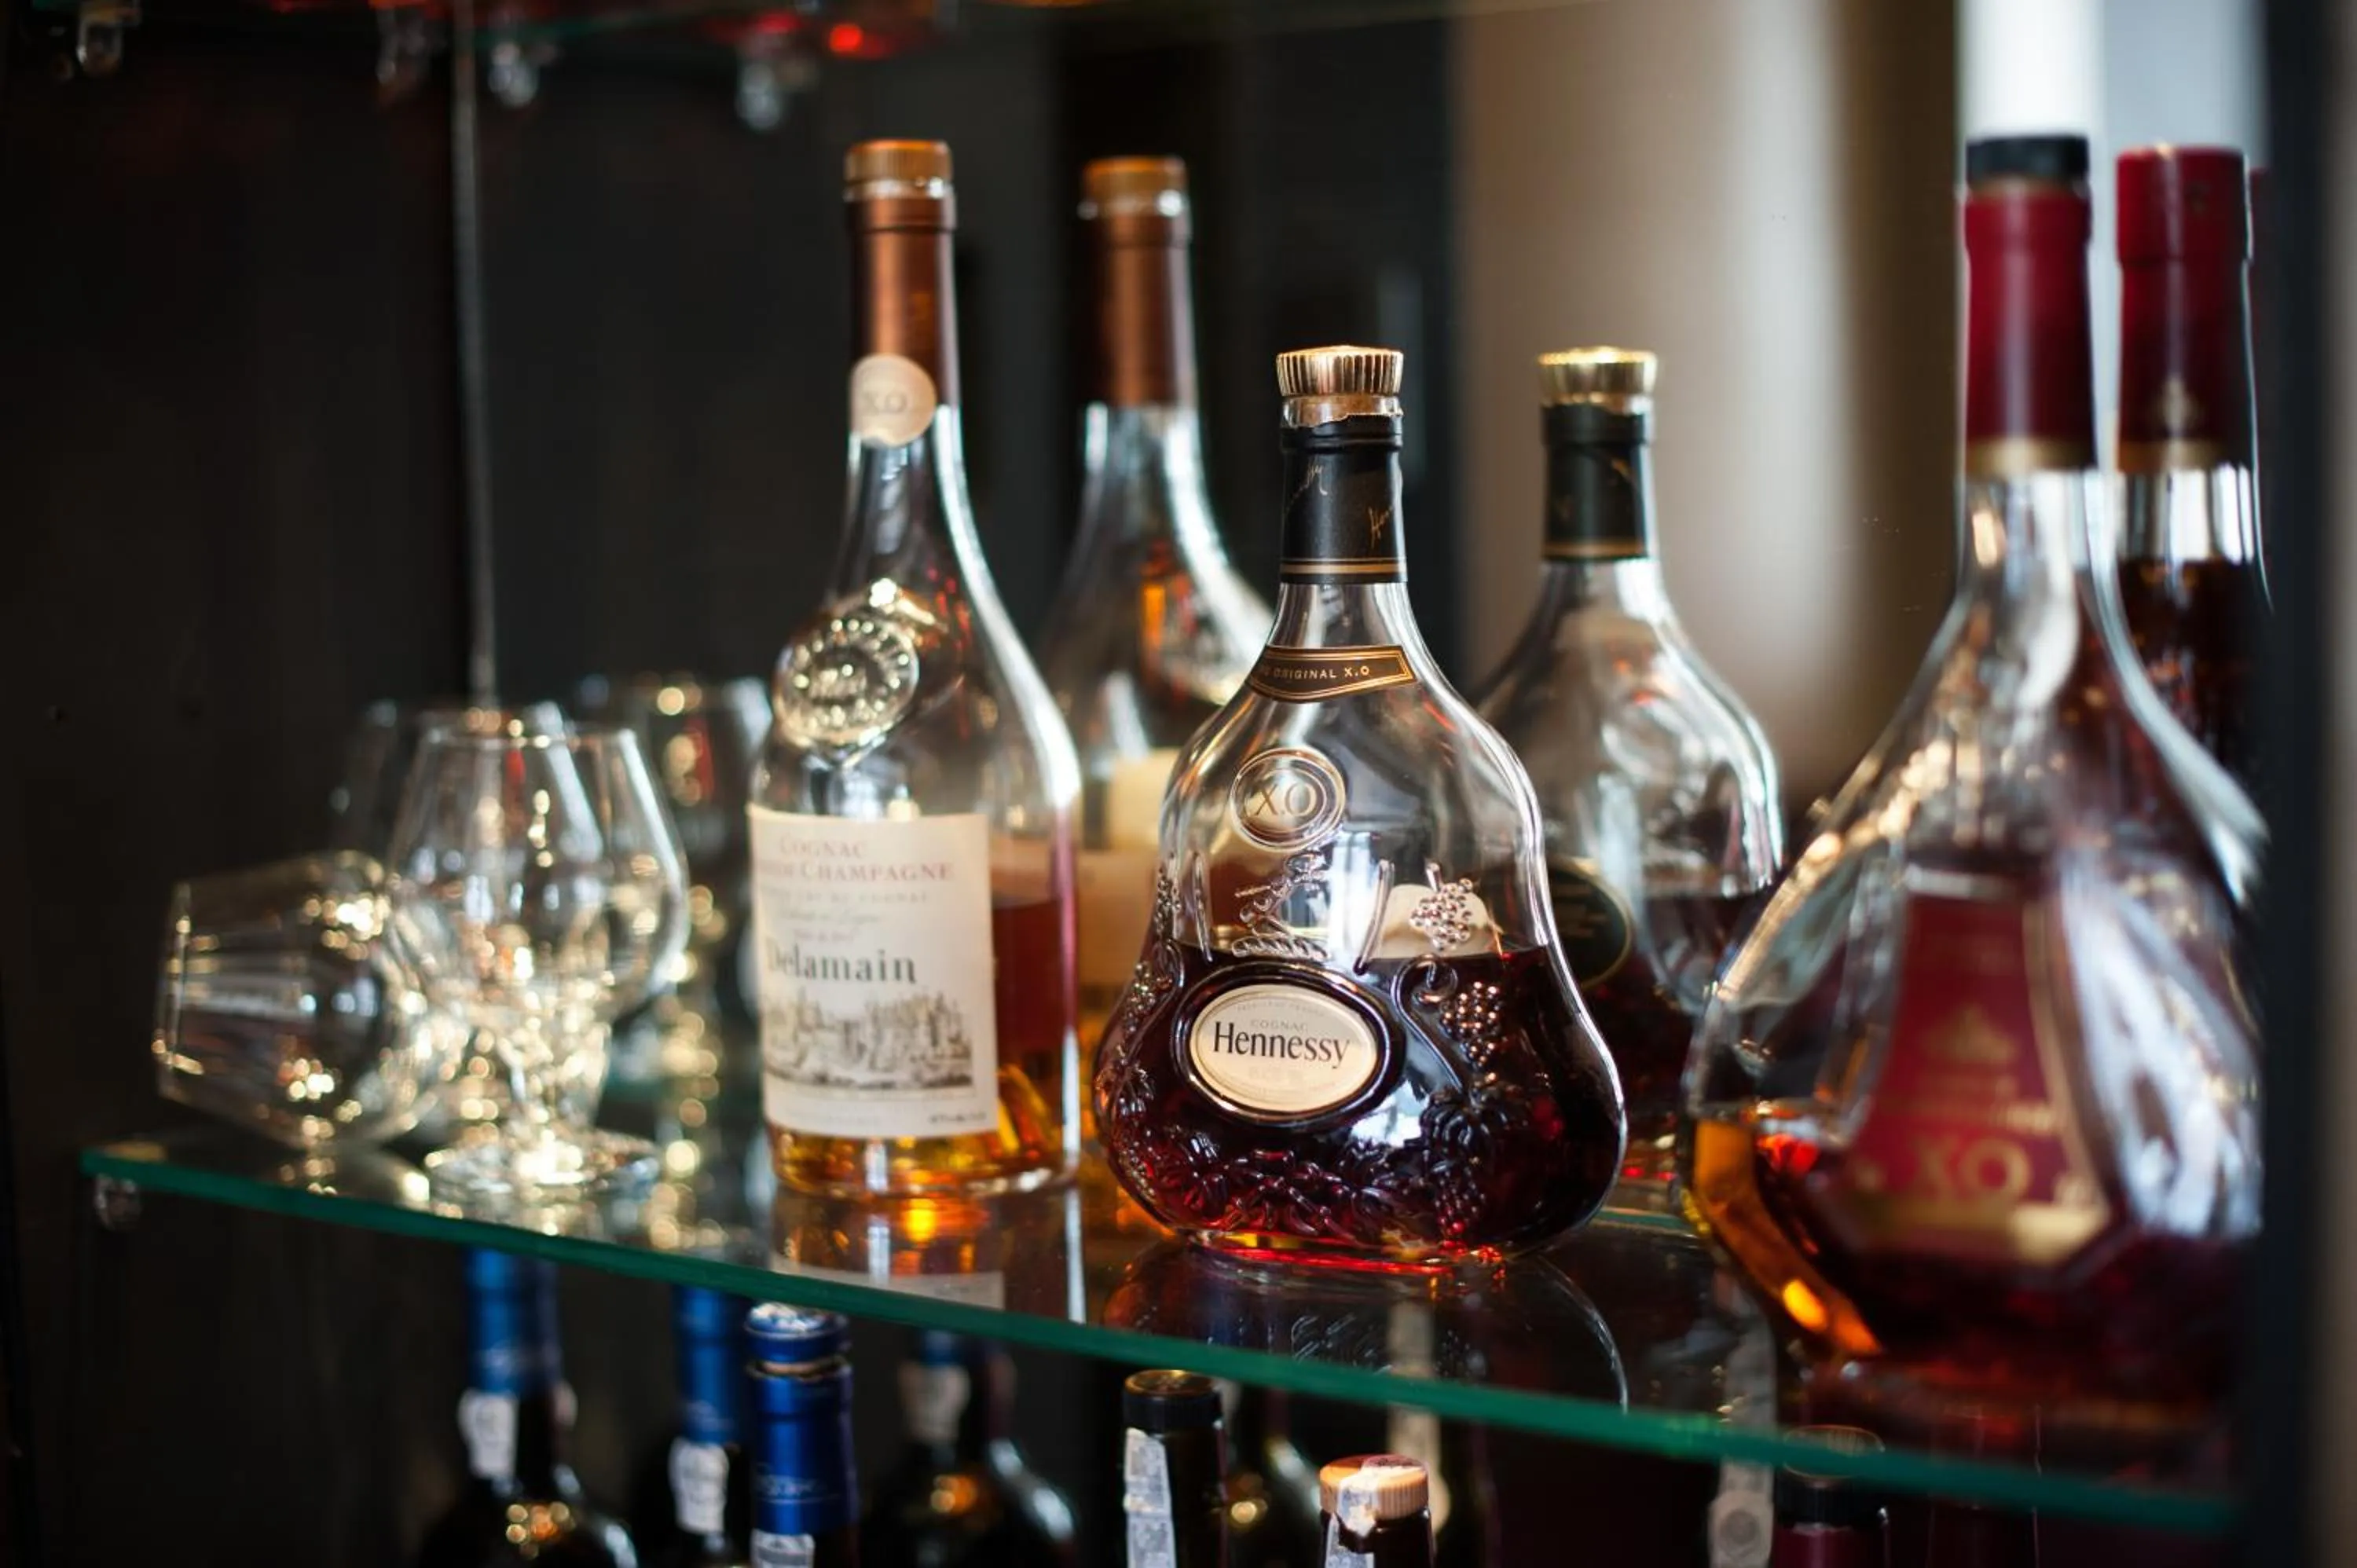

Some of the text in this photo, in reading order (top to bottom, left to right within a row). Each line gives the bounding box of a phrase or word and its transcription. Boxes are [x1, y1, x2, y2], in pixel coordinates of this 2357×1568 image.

[1274, 667, 1337, 680] ORIGINAL
[1344, 665, 1370, 677] X.O
[779, 832, 867, 859] COGNAC
[800, 861, 955, 881] CHAMPAGNE
[764, 936, 917, 984] Delamain
[1251, 1020, 1308, 1034] COGNAC
[1214, 1020, 1351, 1069] Hennessy
